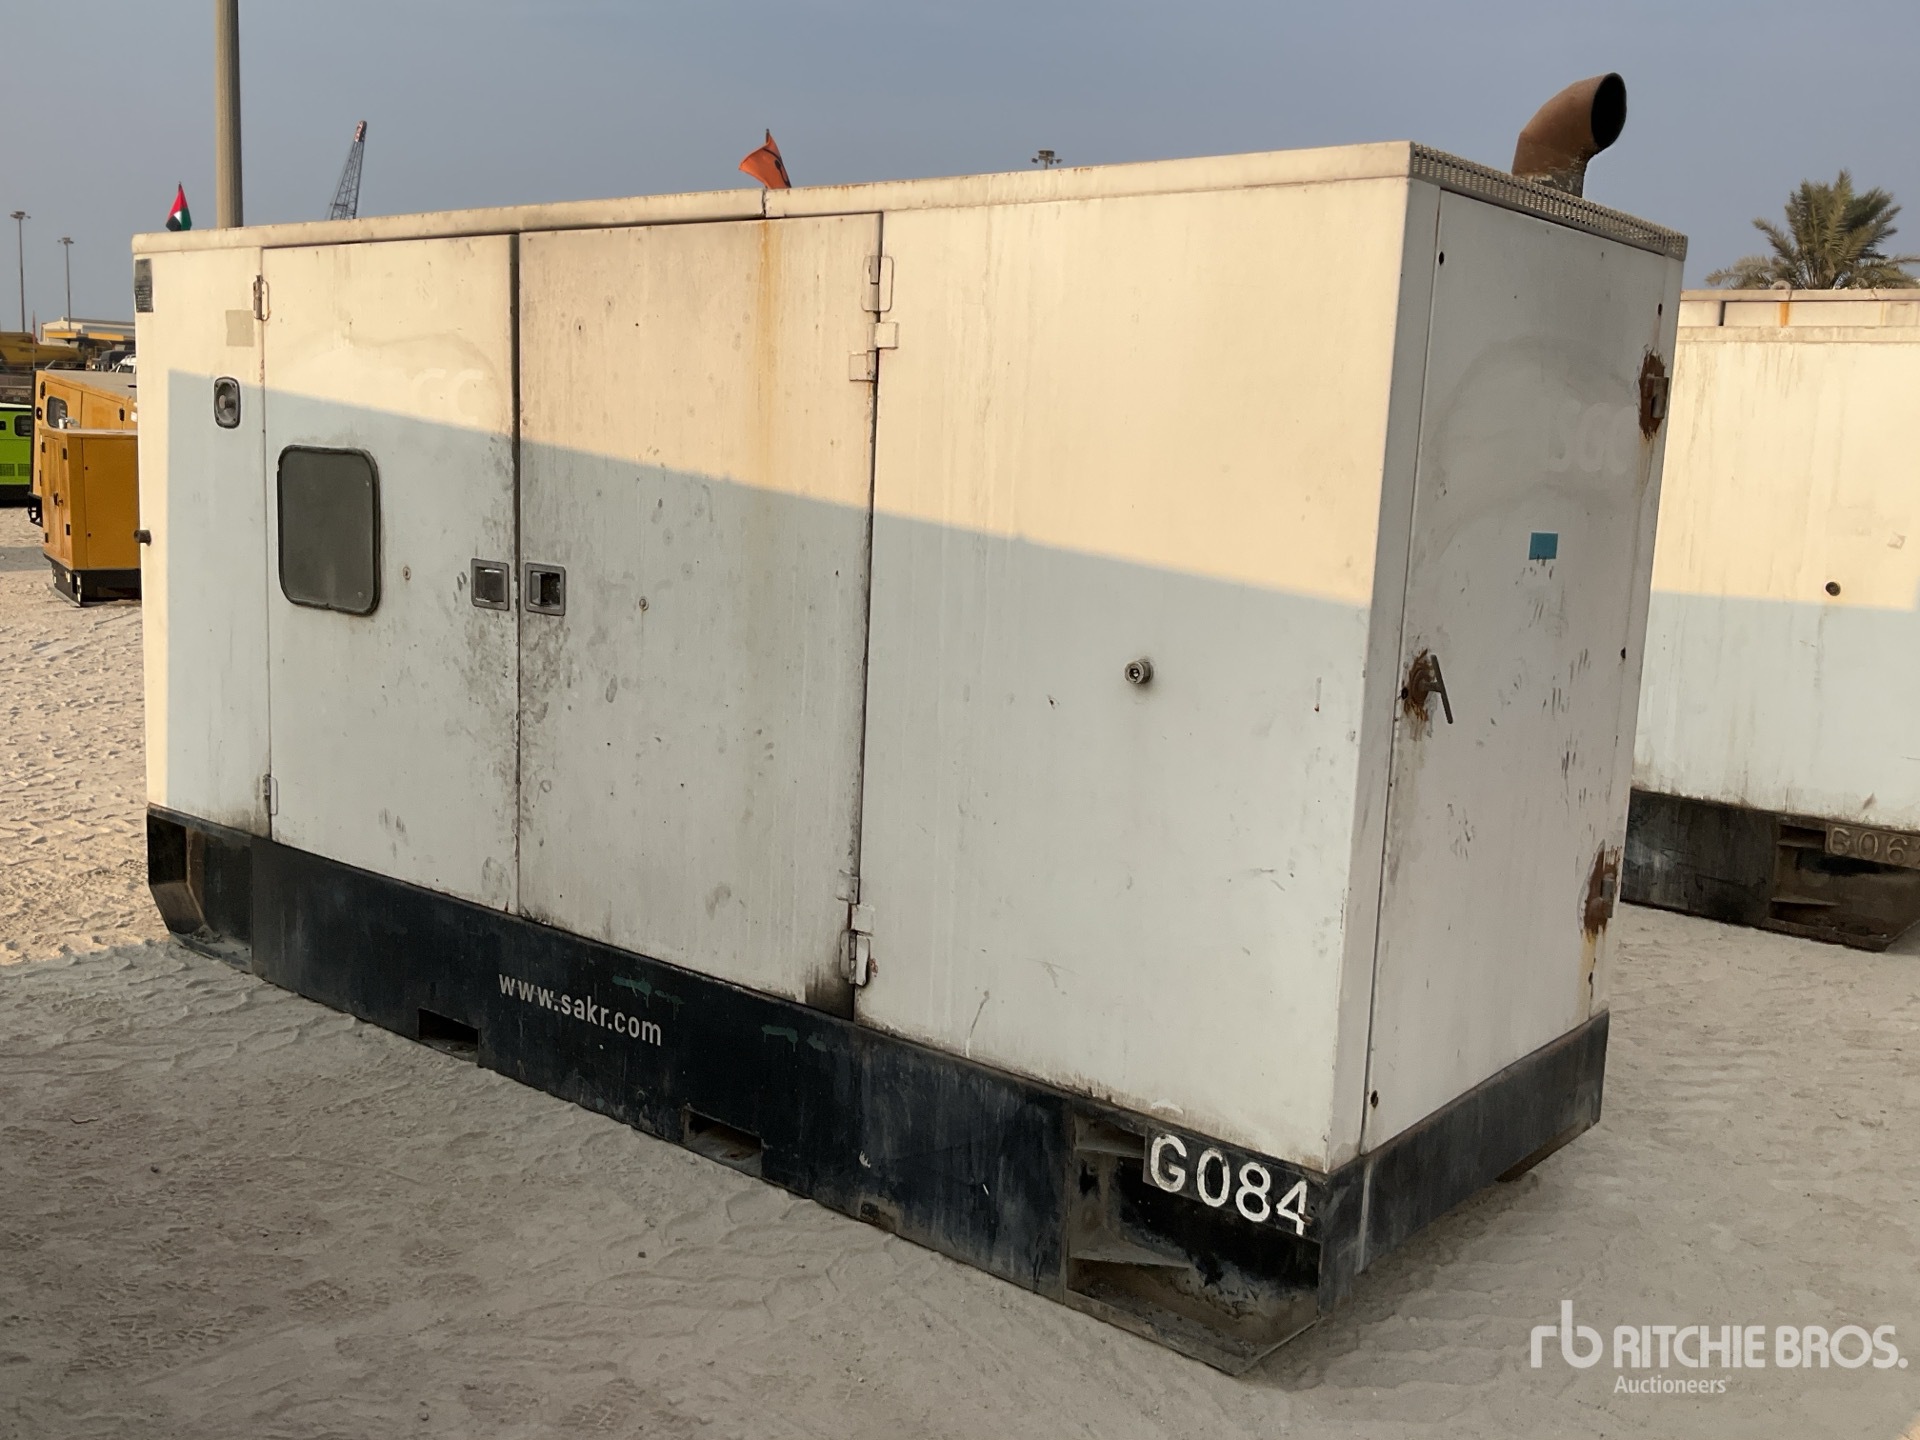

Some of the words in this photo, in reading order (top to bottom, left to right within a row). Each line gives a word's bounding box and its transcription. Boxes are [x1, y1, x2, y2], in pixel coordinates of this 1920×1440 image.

[1829, 826, 1920, 866] G06
[499, 973, 662, 1047] www.sakr.com
[1150, 1133, 1313, 1236] G084
